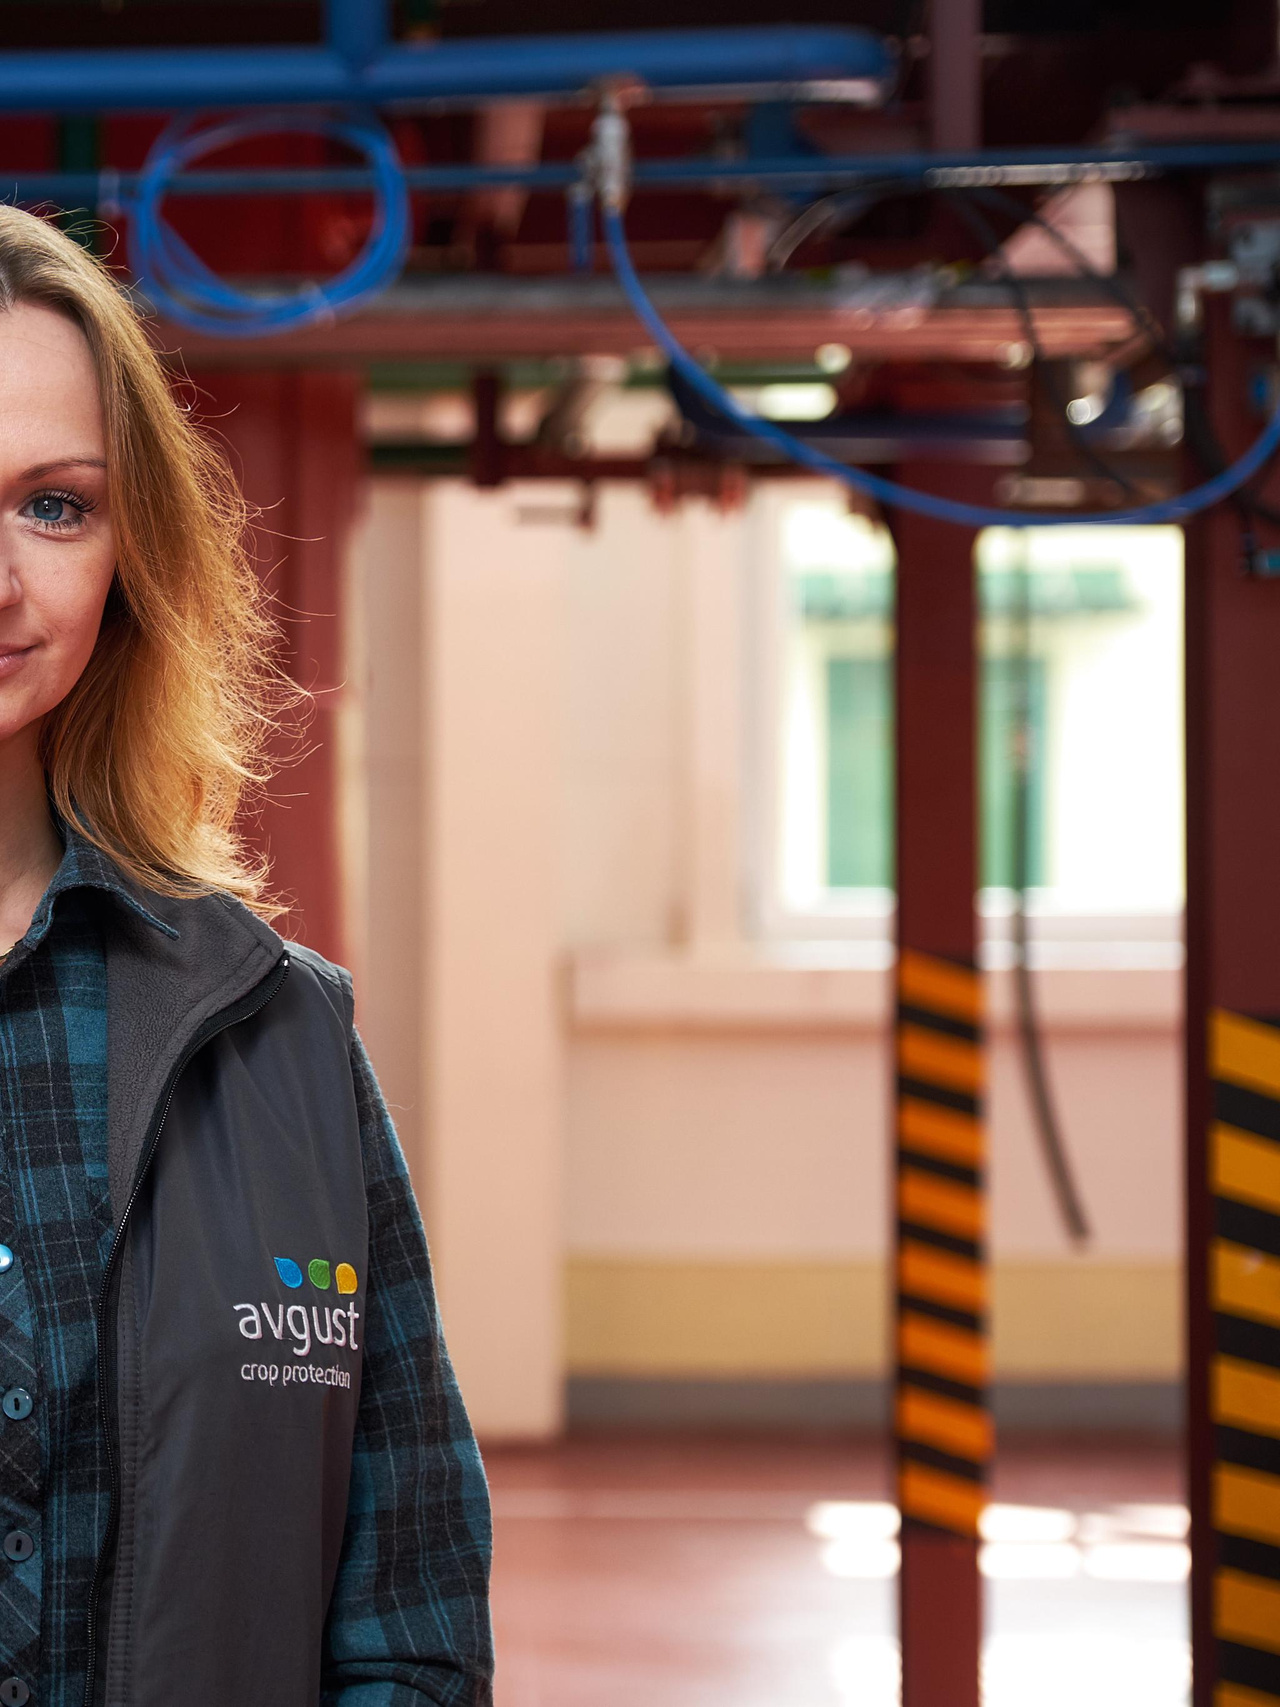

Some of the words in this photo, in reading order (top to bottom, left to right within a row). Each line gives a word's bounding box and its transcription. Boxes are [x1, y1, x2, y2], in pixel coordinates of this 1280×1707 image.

[233, 1301, 360, 1356] avgust
[241, 1363, 278, 1386] crop
[282, 1363, 351, 1389] protection
